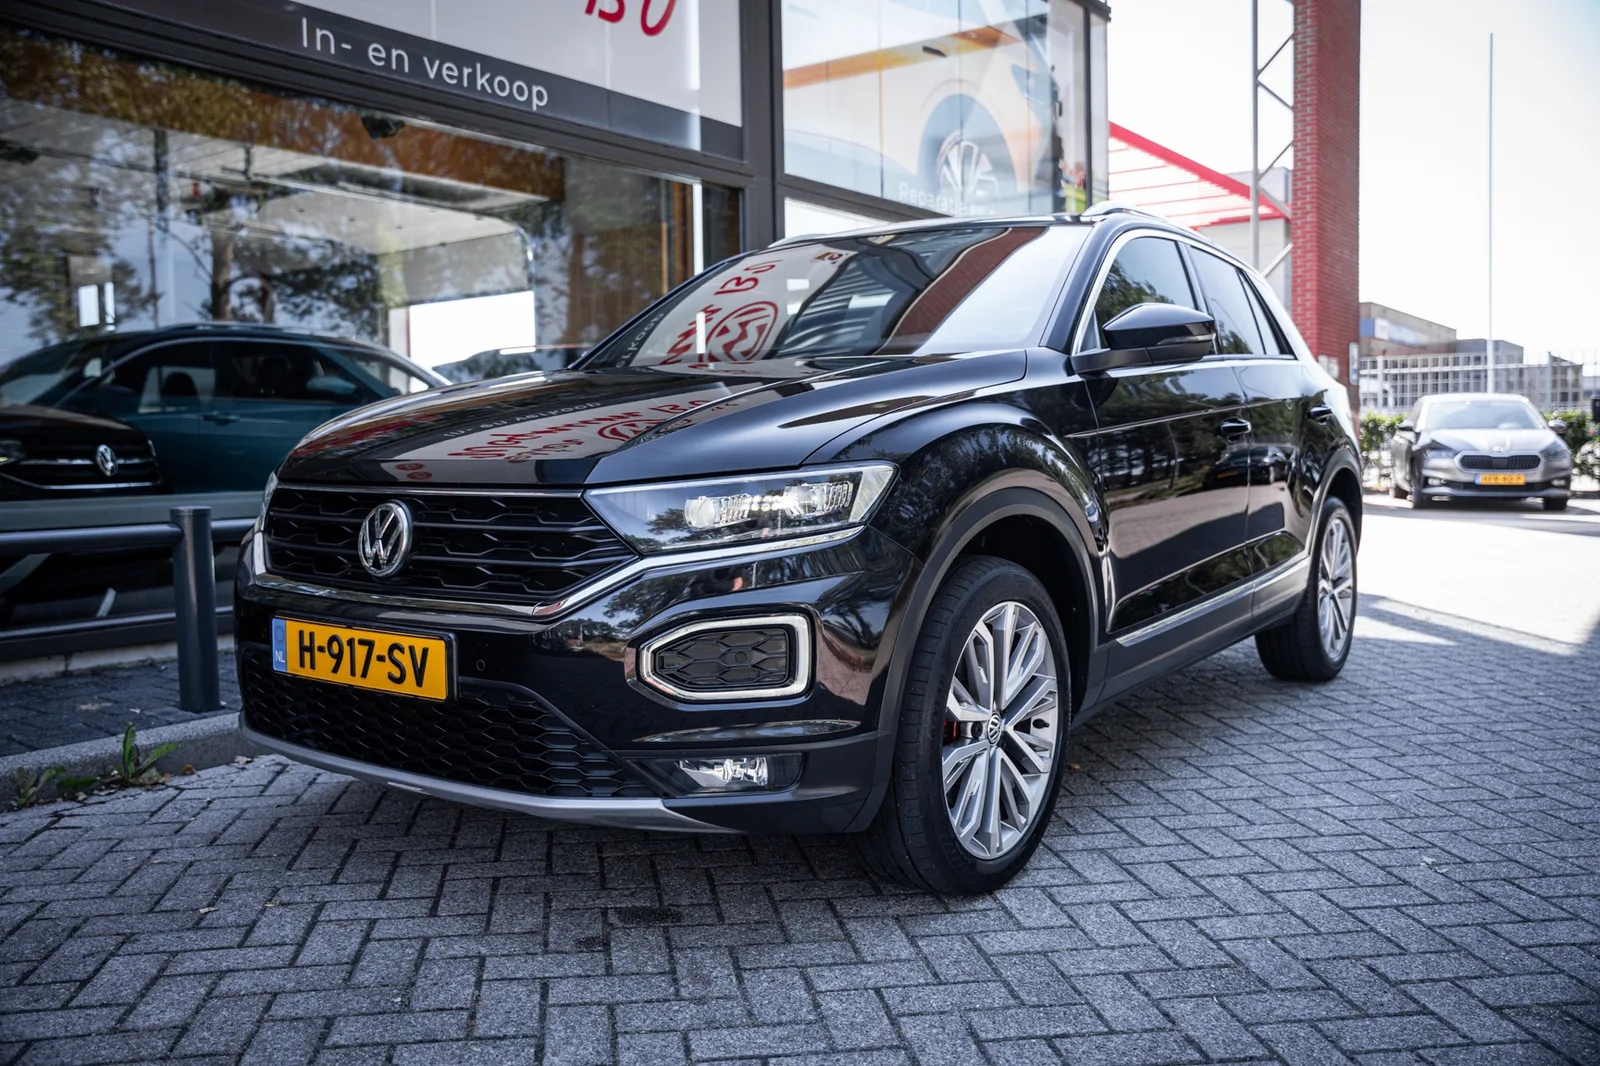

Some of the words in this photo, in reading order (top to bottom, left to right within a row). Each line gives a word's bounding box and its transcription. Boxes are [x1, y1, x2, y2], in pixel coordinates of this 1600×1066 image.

[302, 17, 352, 55] In-
[368, 43, 409, 73] en
[422, 56, 549, 111] verkoop
[275, 650, 286, 663] NL
[298, 629, 429, 688] H-917-SV
